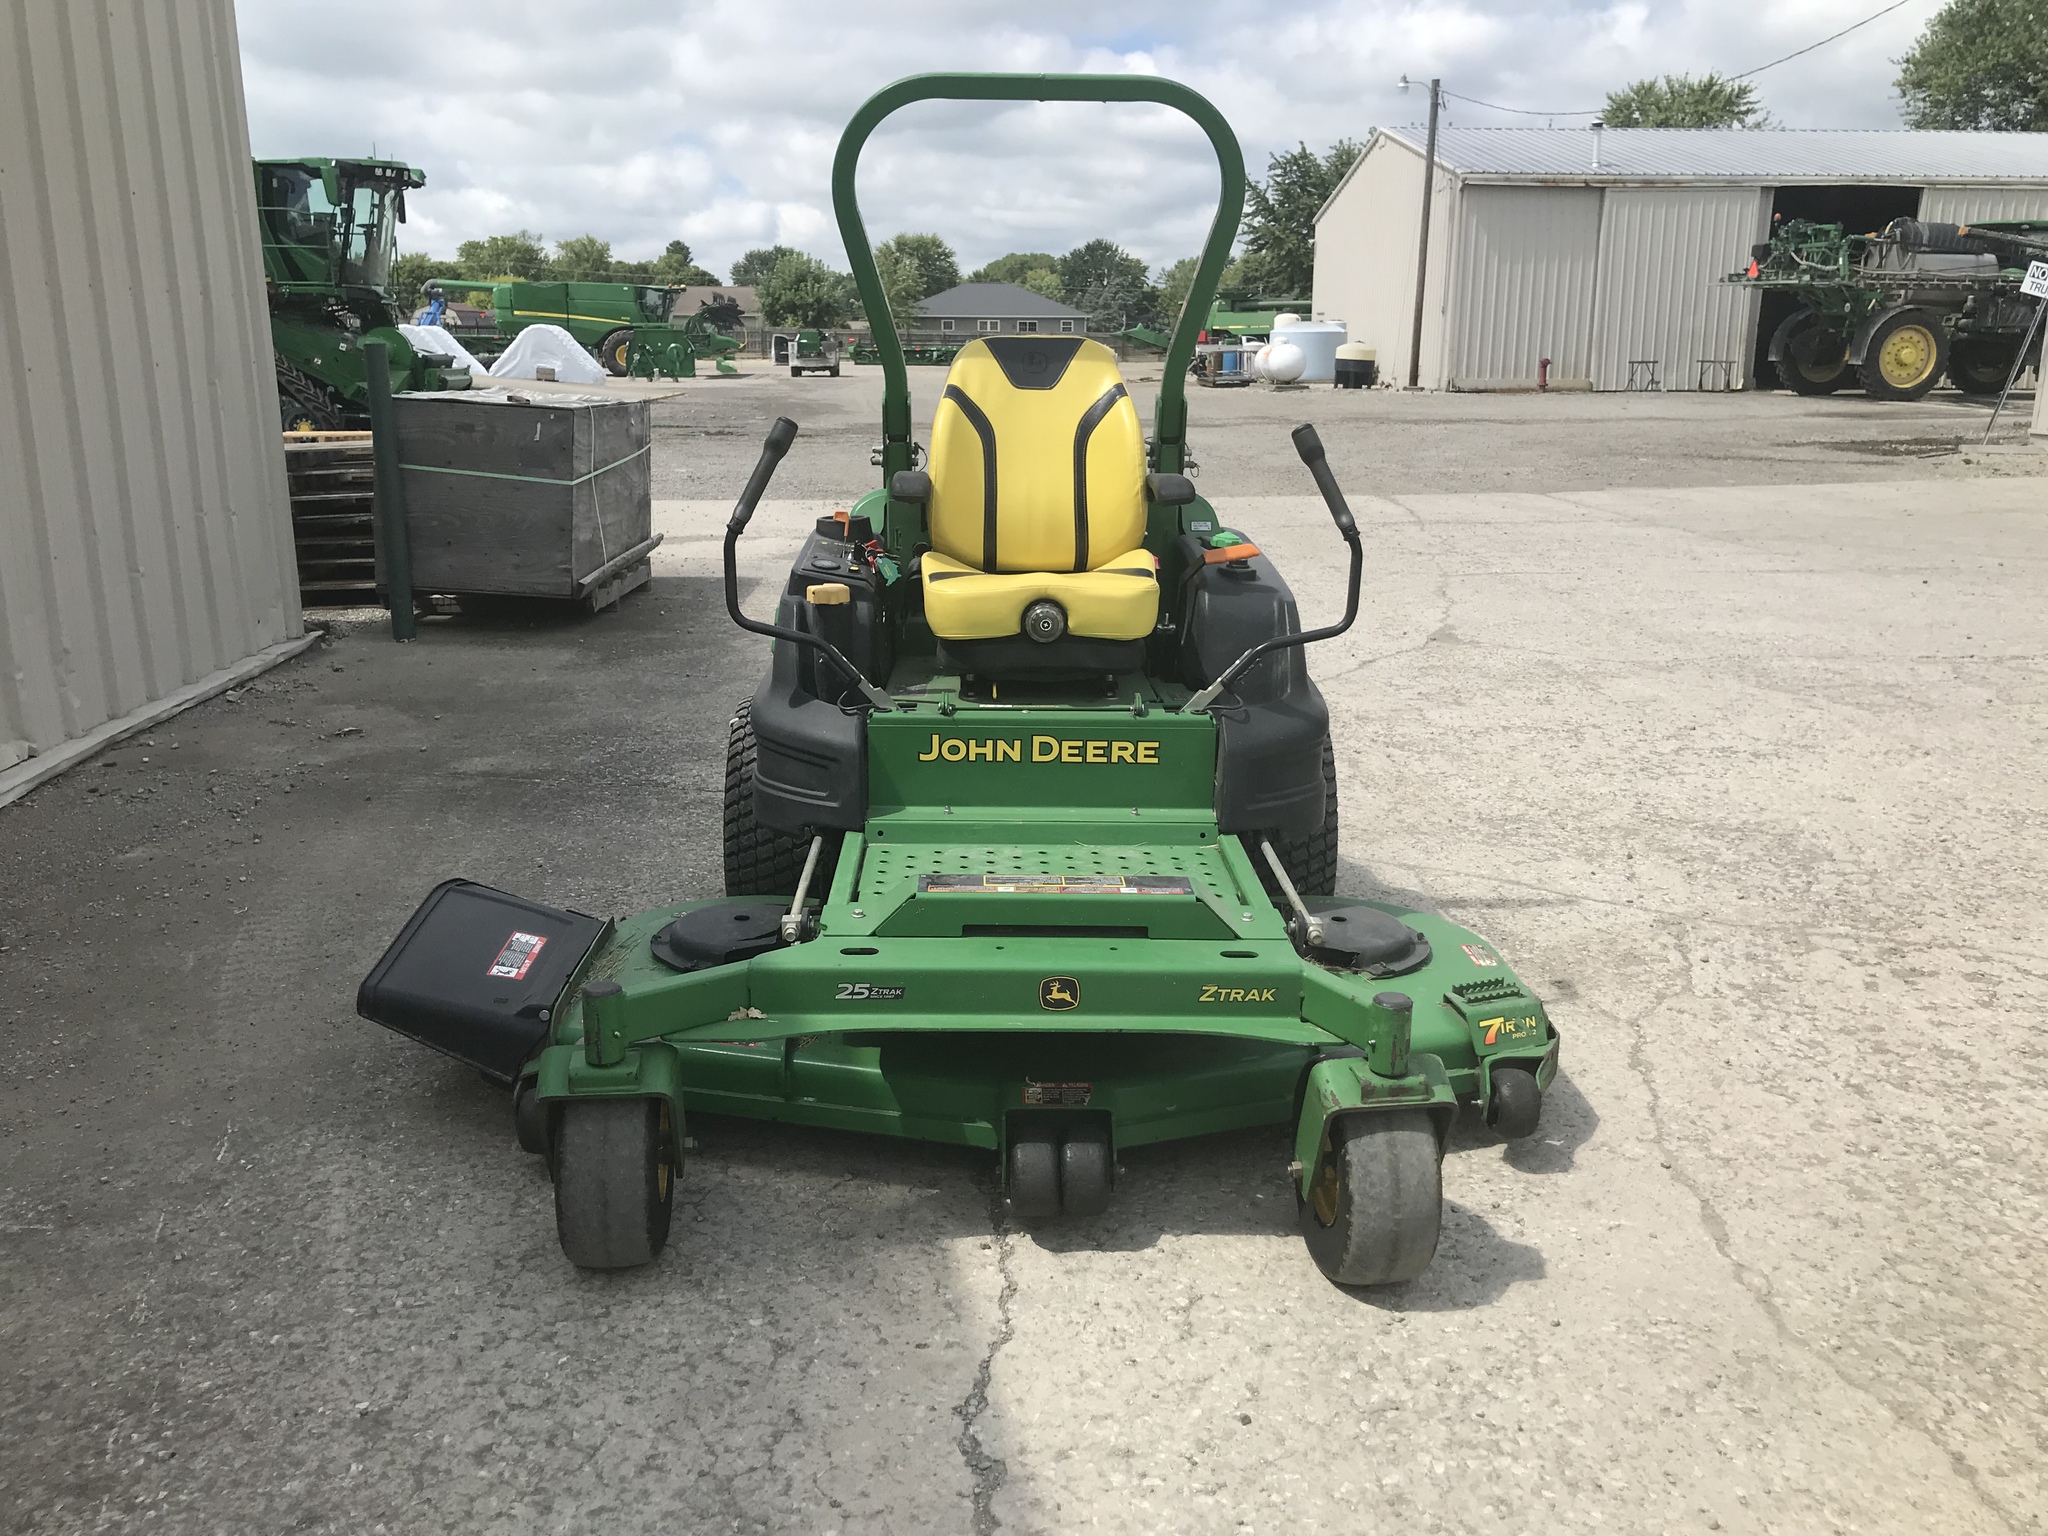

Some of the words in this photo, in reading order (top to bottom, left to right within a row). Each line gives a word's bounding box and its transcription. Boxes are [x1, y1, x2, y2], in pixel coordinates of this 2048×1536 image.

[2030, 265, 2048, 280] NO
[2030, 281, 2048, 294] TRU
[918, 733, 1022, 762] JOHN
[1031, 735, 1160, 764] DEERE
[835, 983, 870, 999] 25
[870, 987, 902, 995] ZTRAK
[1198, 985, 1277, 1002] ZTRAK
